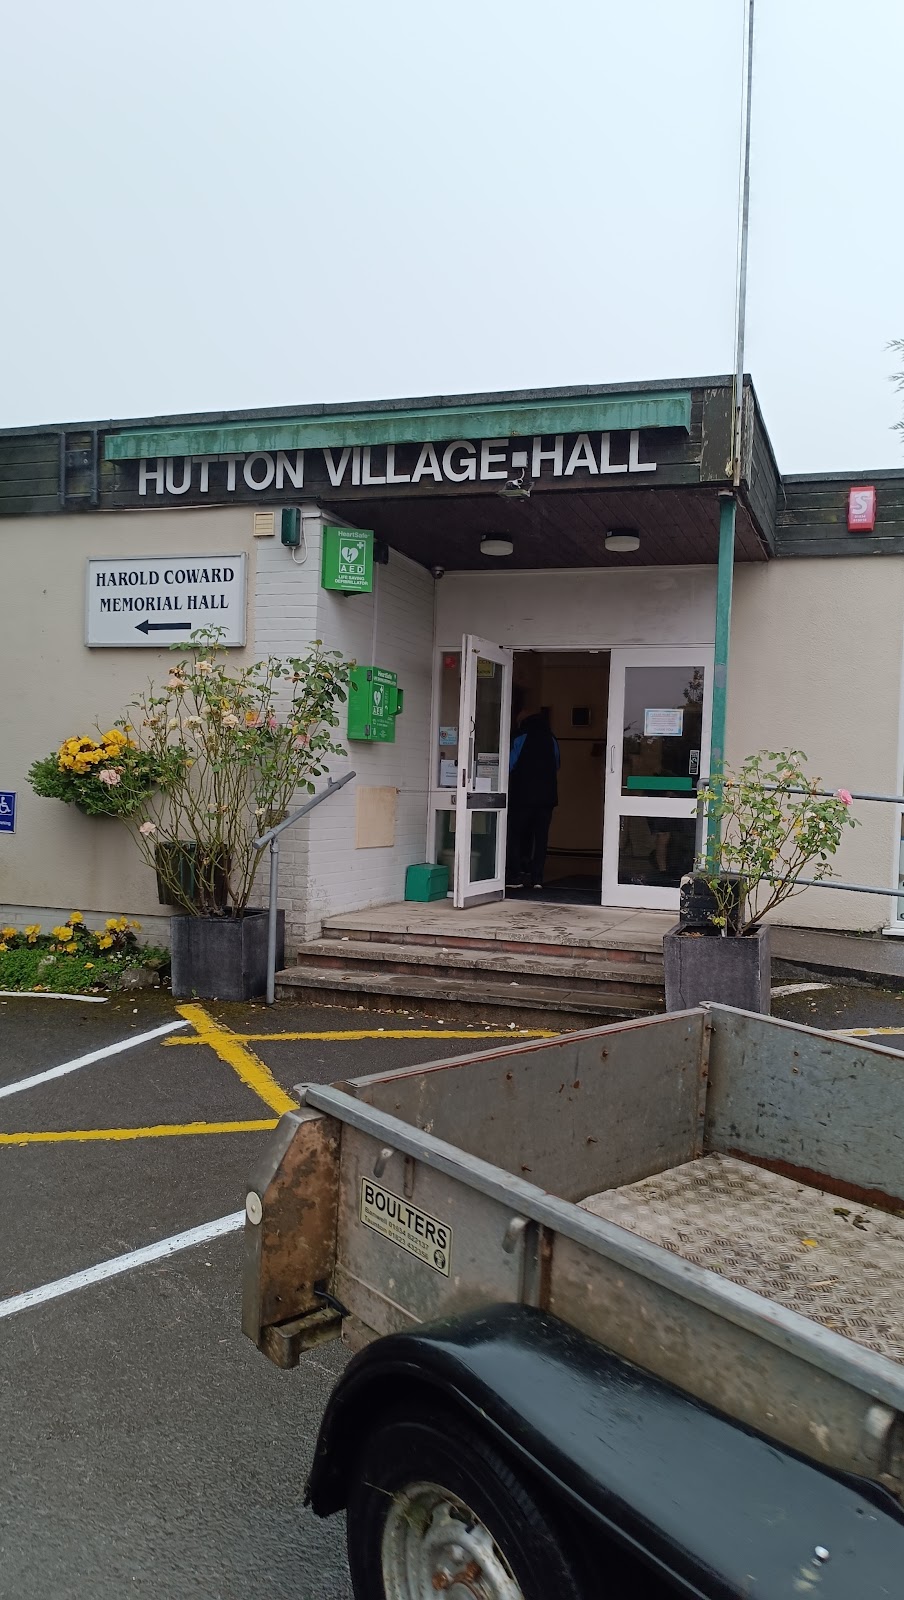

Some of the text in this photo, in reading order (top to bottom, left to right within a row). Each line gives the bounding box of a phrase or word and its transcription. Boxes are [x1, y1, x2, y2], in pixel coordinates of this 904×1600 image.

[138, 430, 657, 496] HUTTON VILLAGE HALL
[337, 530, 369, 539] HeartSafe
[96, 567, 235, 587] HAROLD COWARD
[340, 564, 364, 573] AED
[100, 594, 229, 613] MEMORIAL HALL
[365, 1184, 447, 1250] BOULTERS
